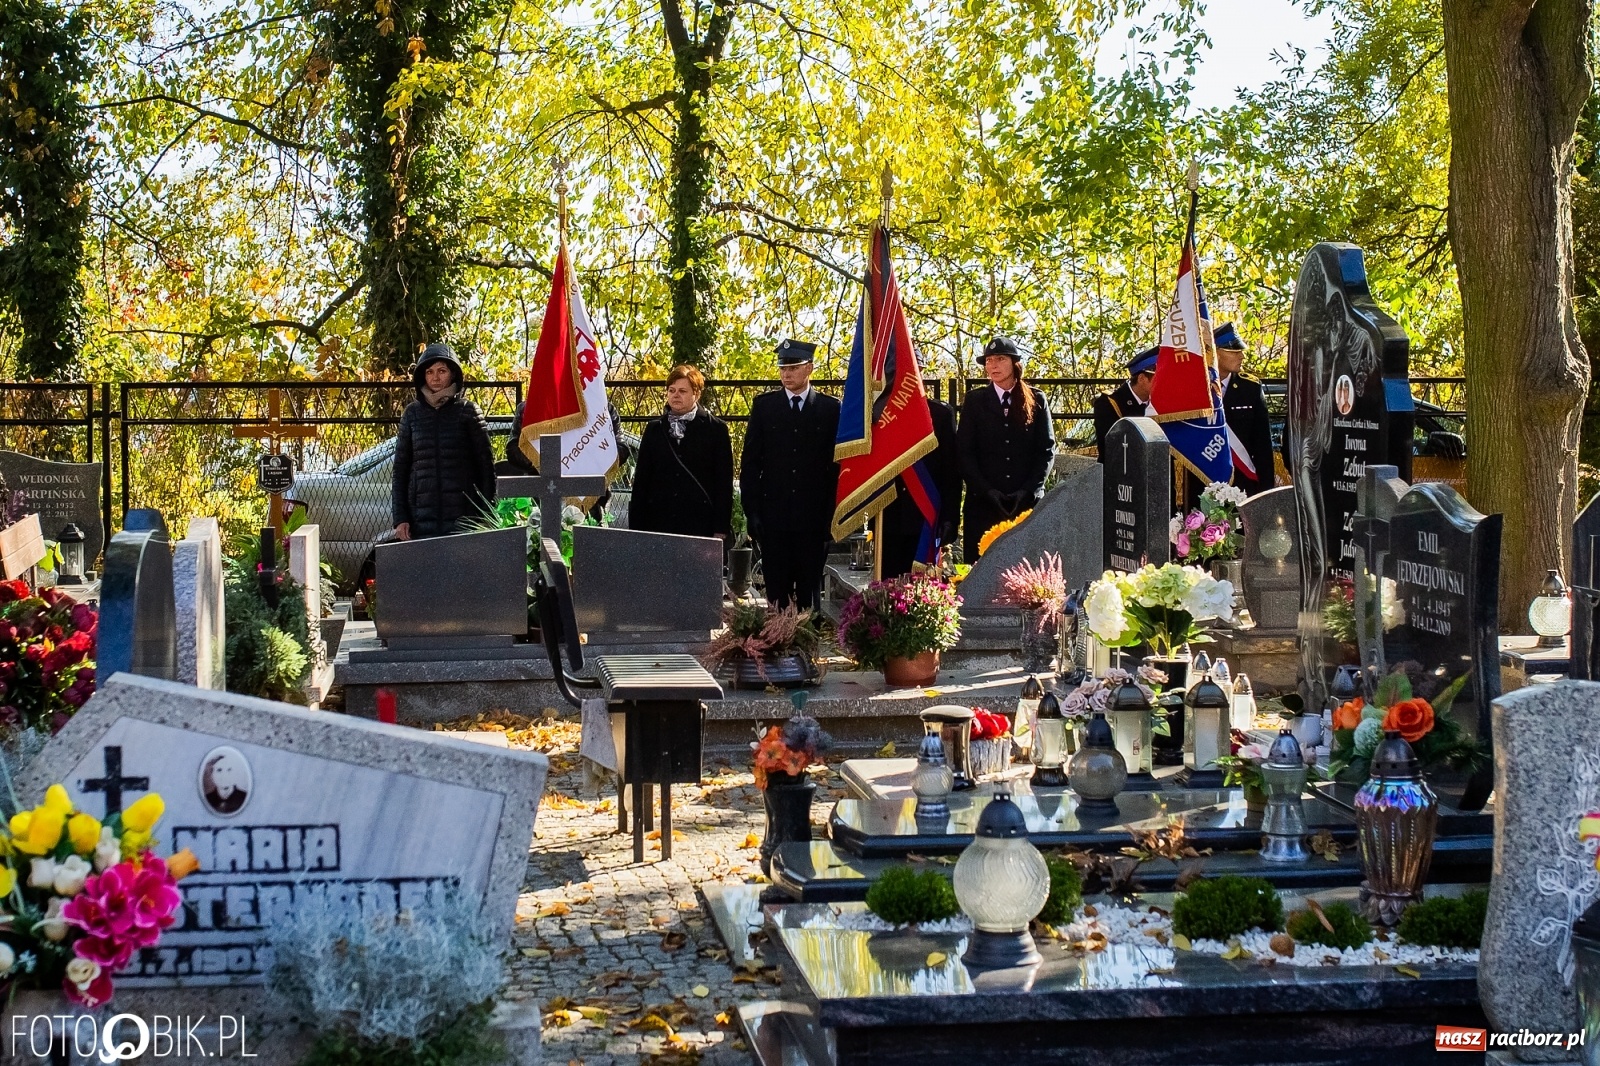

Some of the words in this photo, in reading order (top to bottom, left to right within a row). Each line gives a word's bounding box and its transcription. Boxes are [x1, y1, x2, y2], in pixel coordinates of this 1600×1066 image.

[890, 372, 919, 411] NAMI
[561, 407, 609, 470] Pracownik
[1201, 434, 1226, 462] 1858
[1344, 434, 1367, 452] Iwona
[20, 474, 81, 484] WERONIKA
[1117, 484, 1134, 503] SZOT
[1418, 531, 1441, 555] EMIL
[175, 826, 339, 871] MARIA
